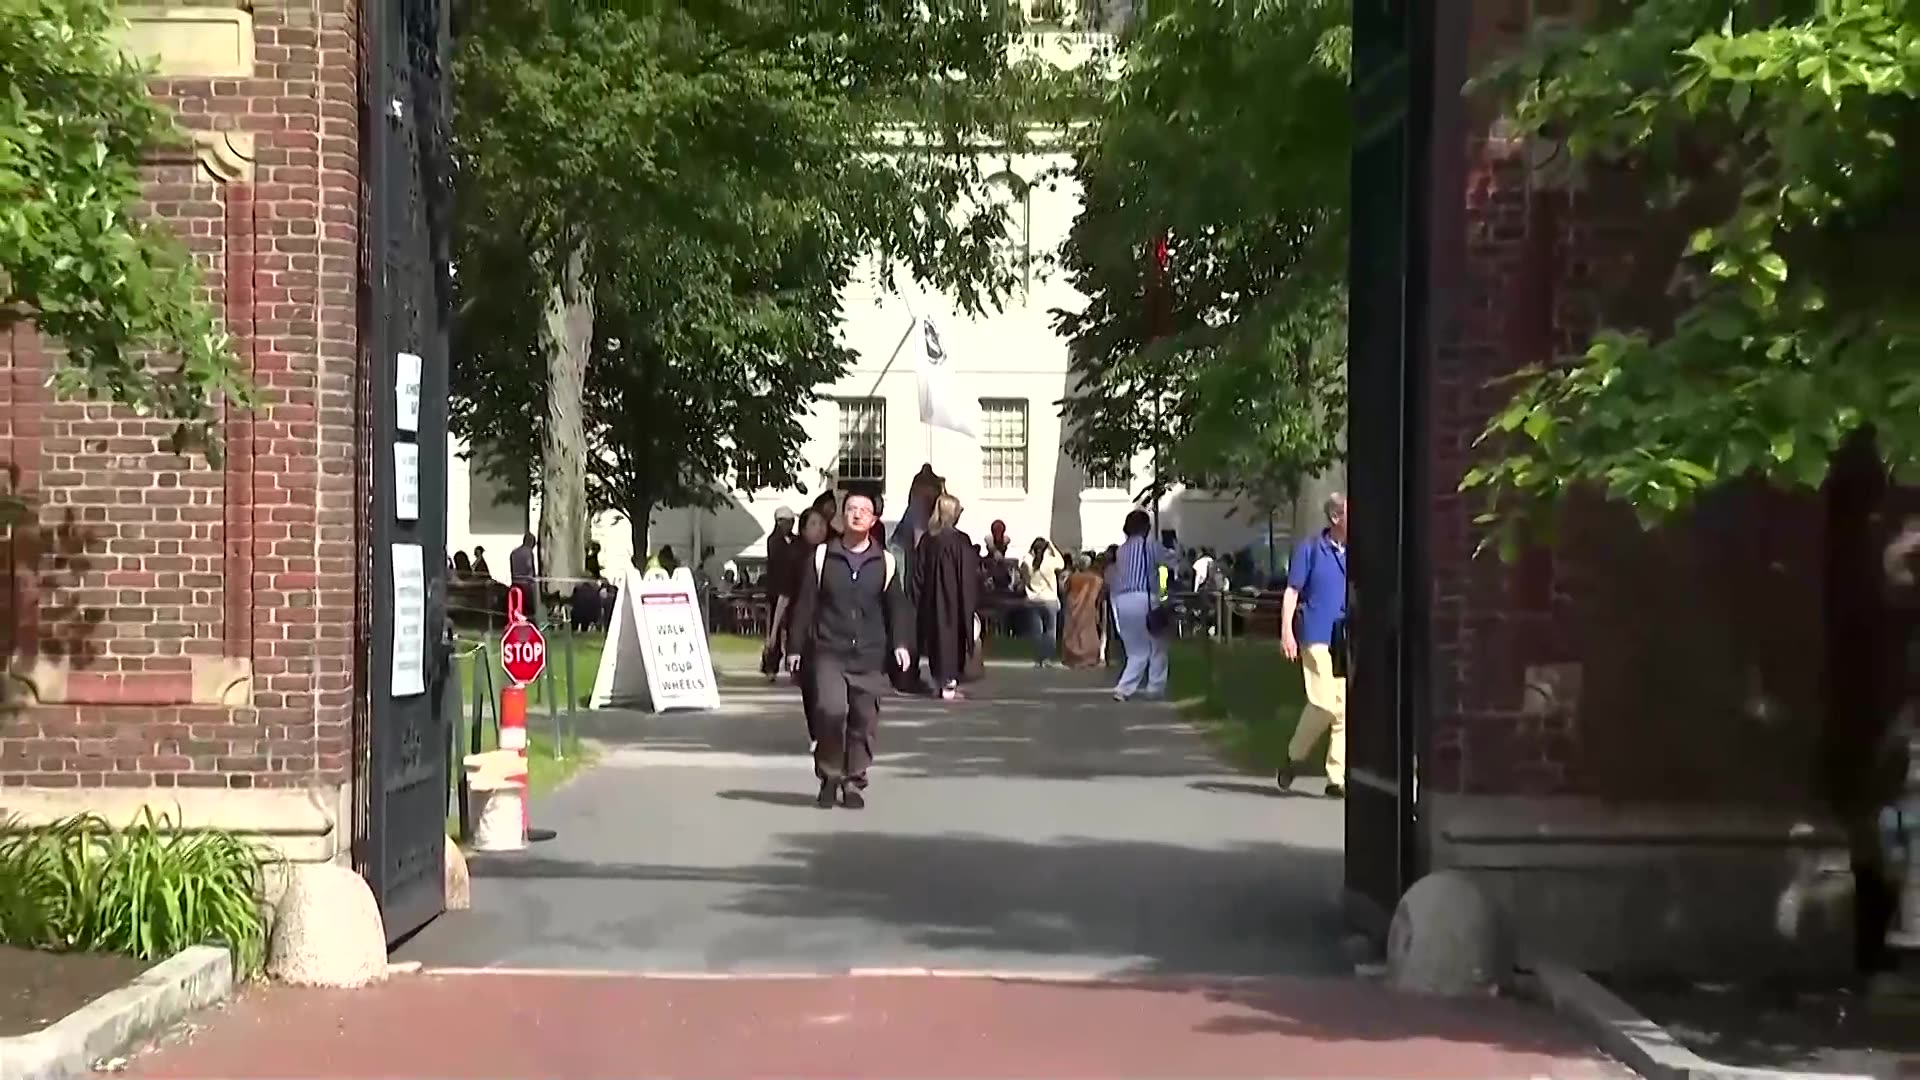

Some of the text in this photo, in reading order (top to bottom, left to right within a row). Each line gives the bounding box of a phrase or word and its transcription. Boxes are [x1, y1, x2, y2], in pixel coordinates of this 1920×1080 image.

[657, 624, 685, 635] WALK
[504, 643, 543, 663] STOP
[665, 661, 692, 673] YOUR
[662, 679, 705, 690] WHEELS
